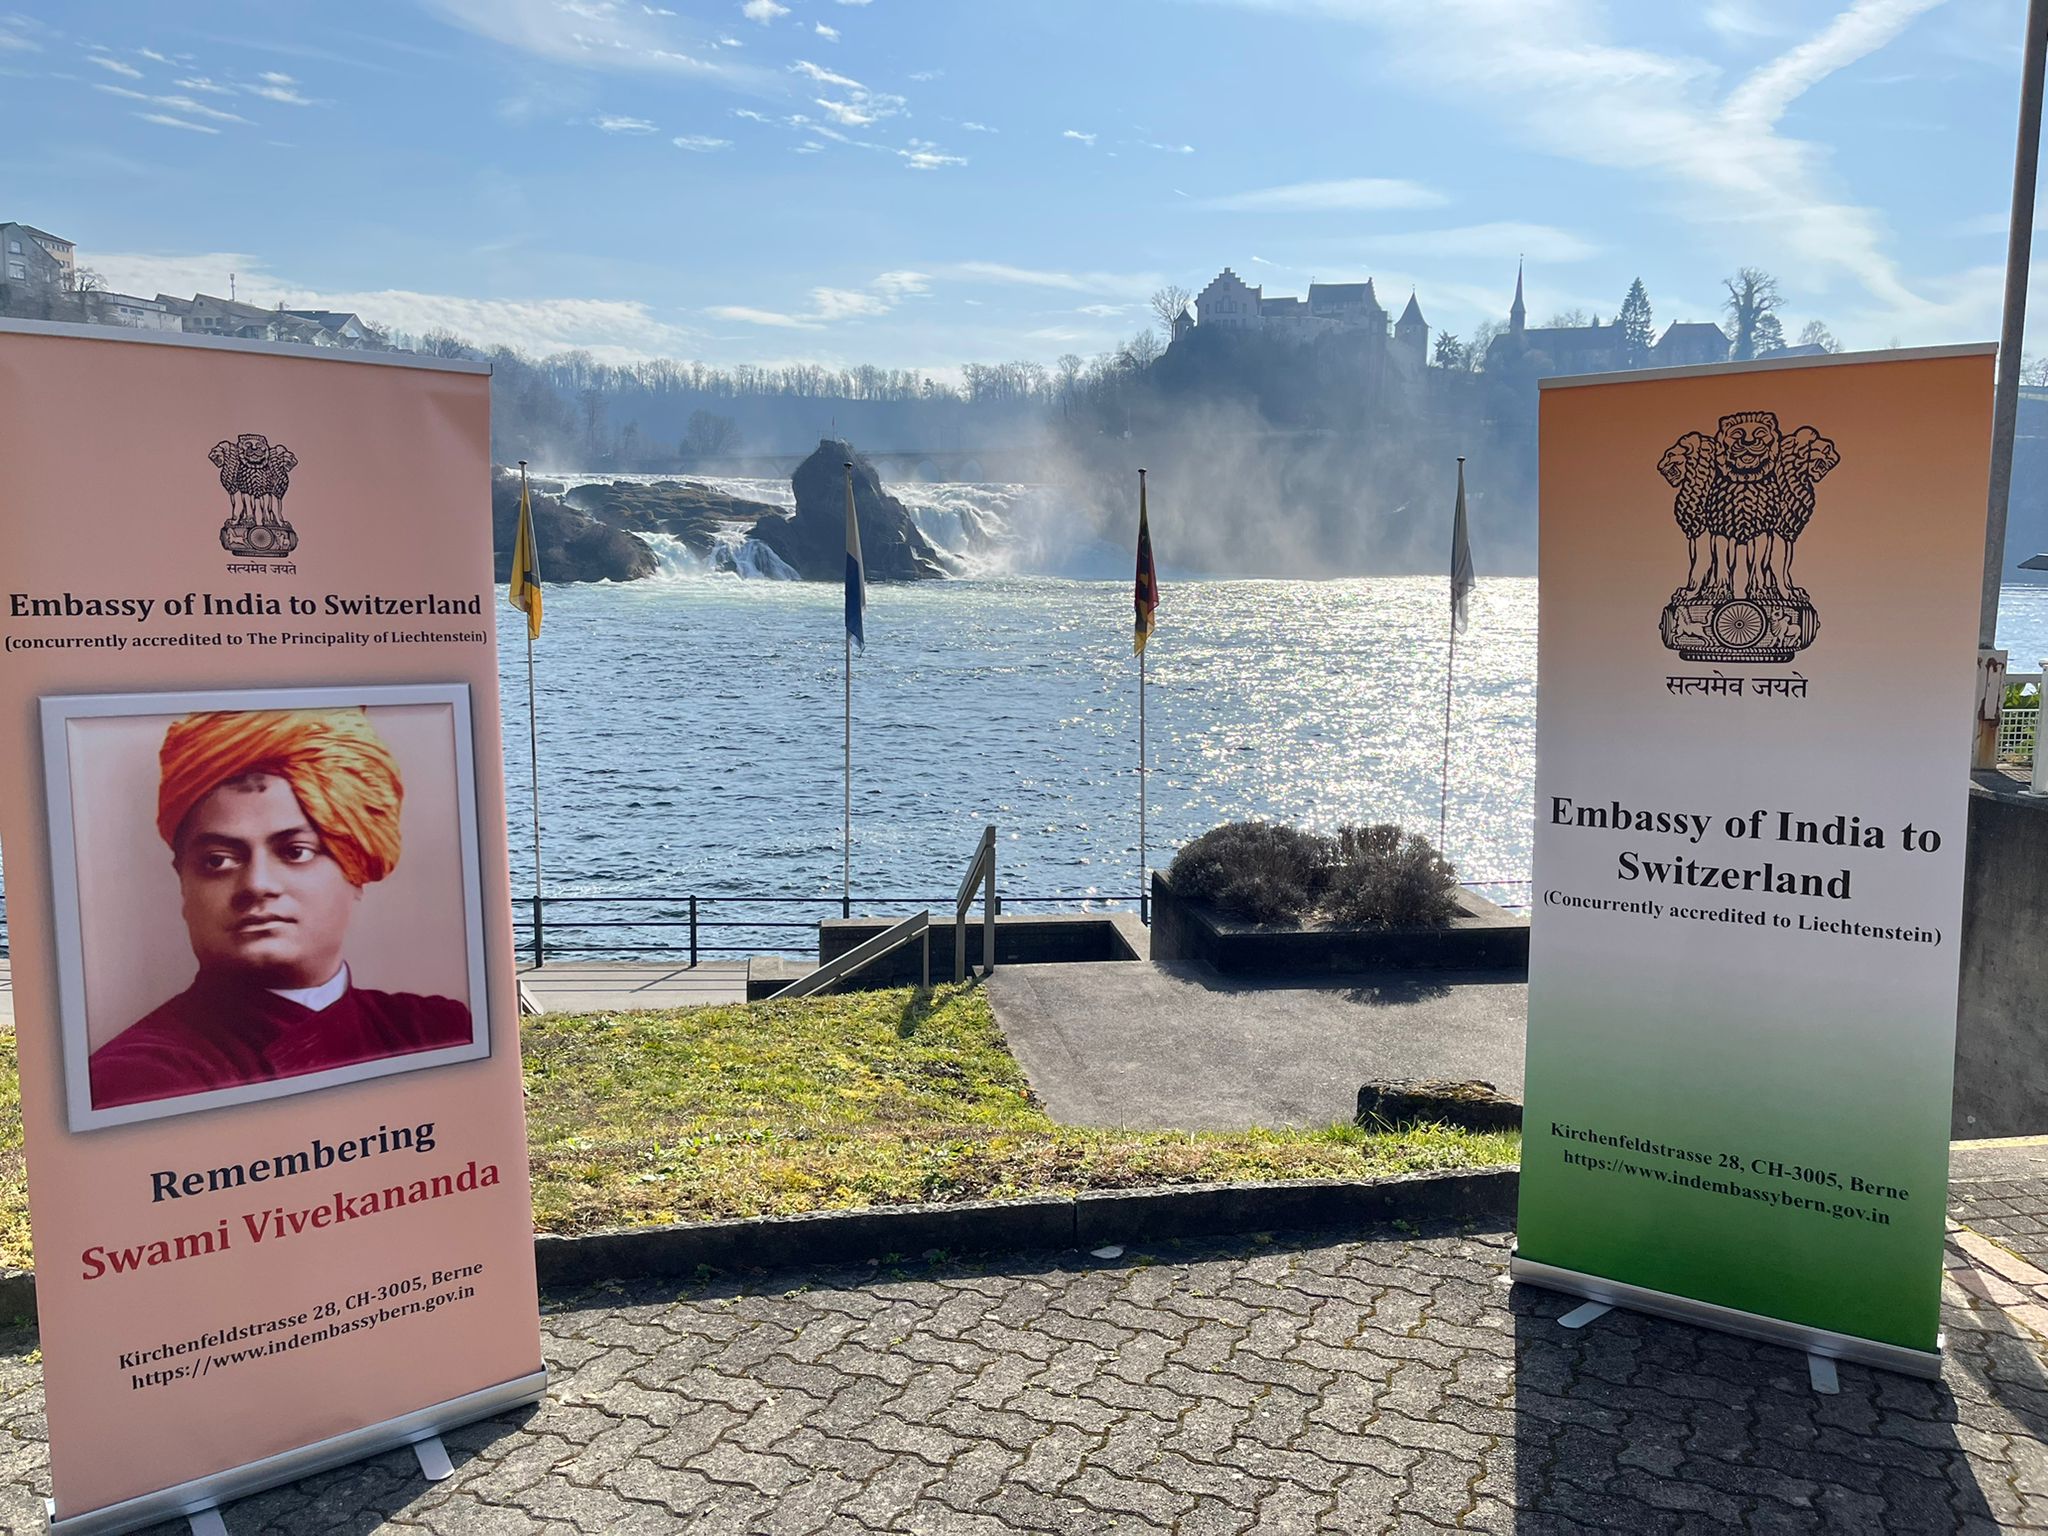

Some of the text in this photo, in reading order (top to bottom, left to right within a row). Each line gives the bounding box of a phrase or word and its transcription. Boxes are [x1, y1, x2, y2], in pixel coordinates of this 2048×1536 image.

[227, 561, 297, 576] सत्यमेव जयते
[9, 592, 482, 622] Embassy of India to Switzerland
[5, 629, 487, 652] (concurrently accredited to The Principality of Liechtenstein)
[1666, 670, 1809, 699] सत्यमेव जयते
[1551, 796, 1941, 853] Embassy of India to
[1617, 851, 1853, 900] Switzerland
[1543, 889, 1942, 947] (Concurrently accredited to Liechtenstein)
[151, 1122, 436, 1203] Remembering
[1550, 1122, 1910, 1201] Kirchenfeldstrasse 28, CH-3005, Berne
[1563, 1150, 1890, 1225] https://www.indembassybern.gov.in
[81, 1161, 500, 1280] Swami Vivekananda
[119, 1263, 483, 1370] Kirchenfeldstrasse 28, CH-3005, Berne
[132, 1284, 475, 1390] https://www.indembassybern.gov.in
